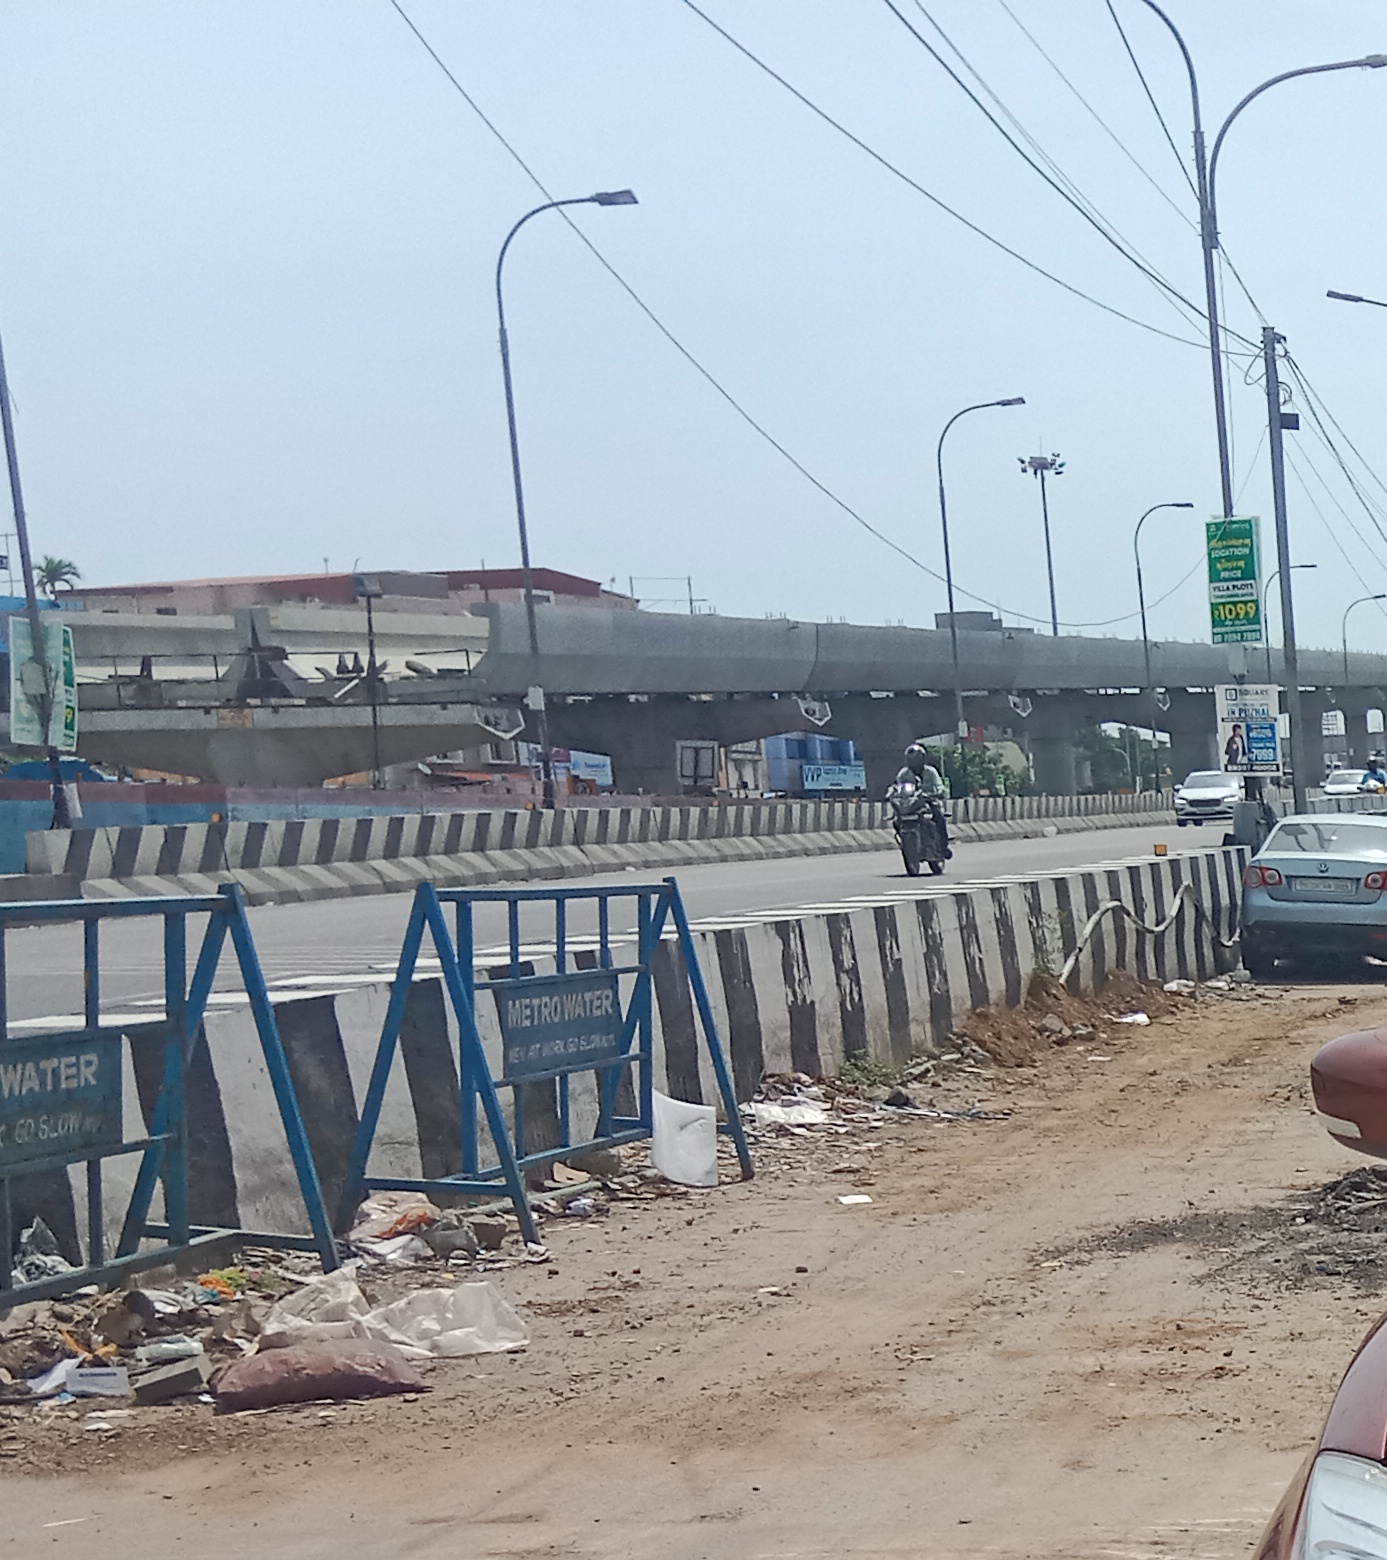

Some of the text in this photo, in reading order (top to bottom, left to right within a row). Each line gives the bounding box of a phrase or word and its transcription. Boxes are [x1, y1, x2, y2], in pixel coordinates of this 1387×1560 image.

[1211, 547, 1250, 558] LOCATION
[1238, 707, 1270, 717] PUZHAL
[508, 988, 613, 1029] METRO WATER
[0, 1053, 99, 1099] WATER
[39, 1112, 81, 1140] SLOW
